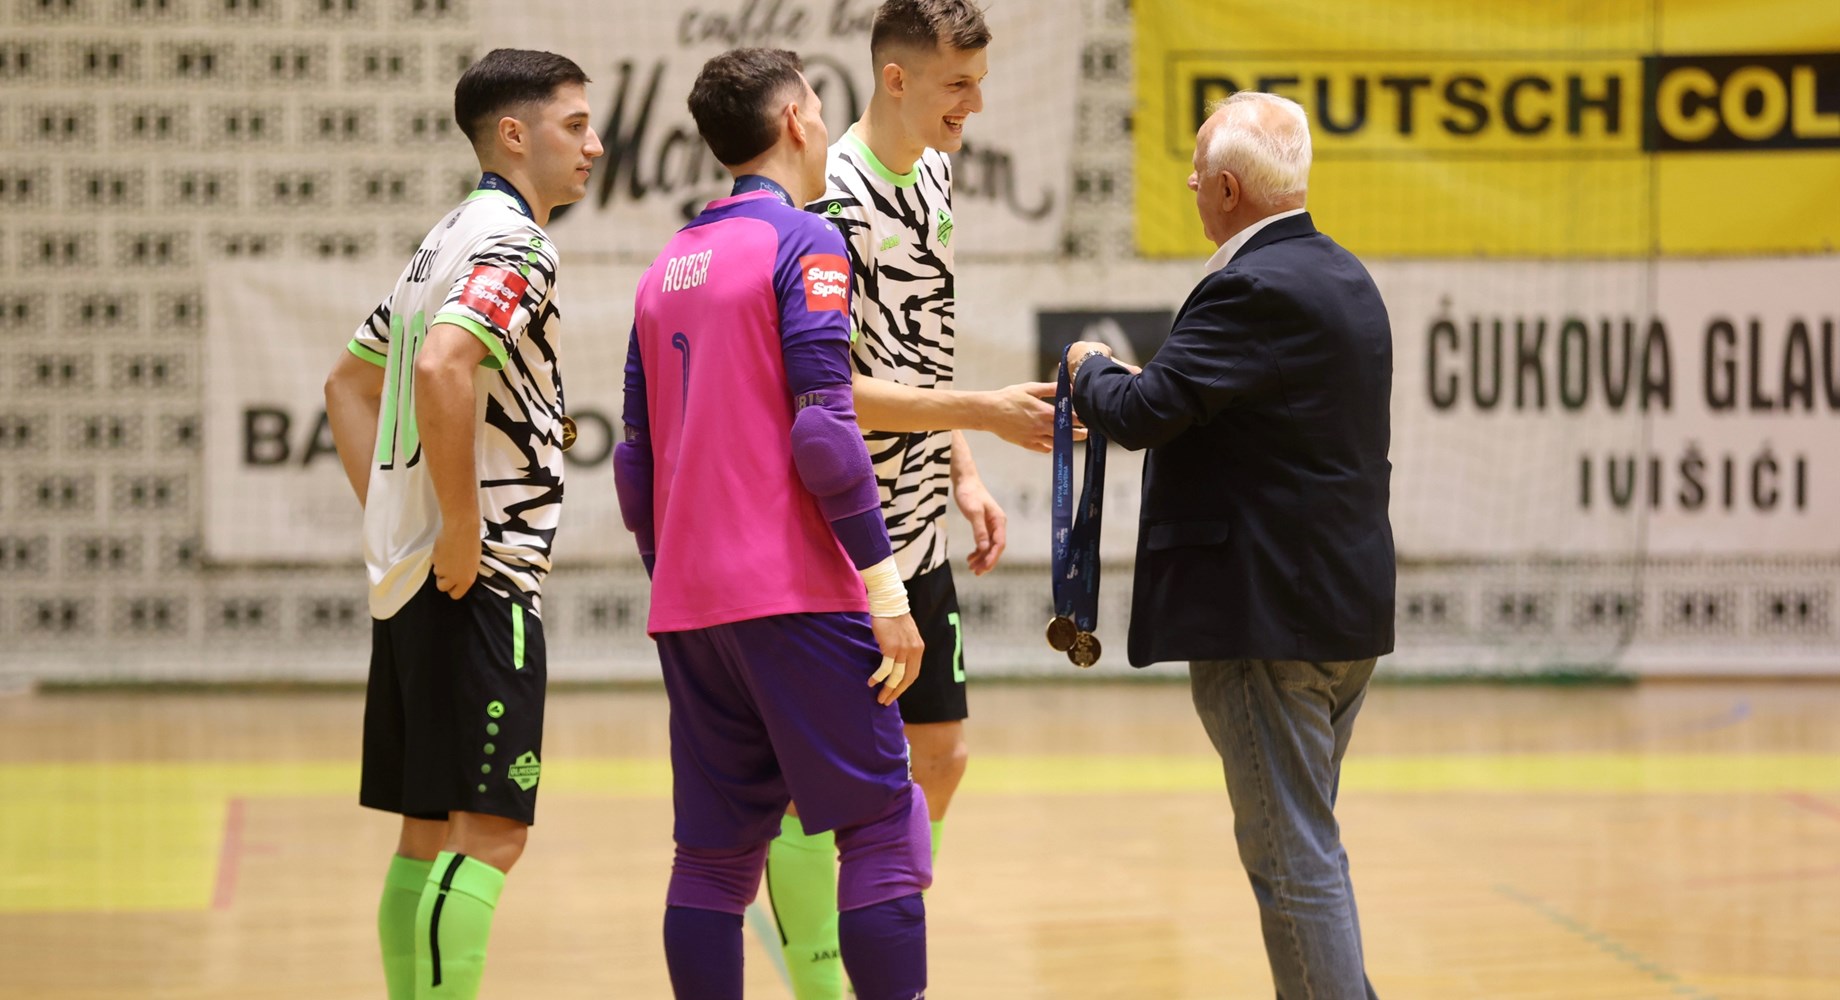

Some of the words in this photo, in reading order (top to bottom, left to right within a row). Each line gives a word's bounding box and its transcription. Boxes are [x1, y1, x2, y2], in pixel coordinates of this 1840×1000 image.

[471, 274, 519, 300] Super
[807, 267, 848, 286] Super
[469, 284, 511, 313] Sport
[811, 281, 847, 299] Sport
